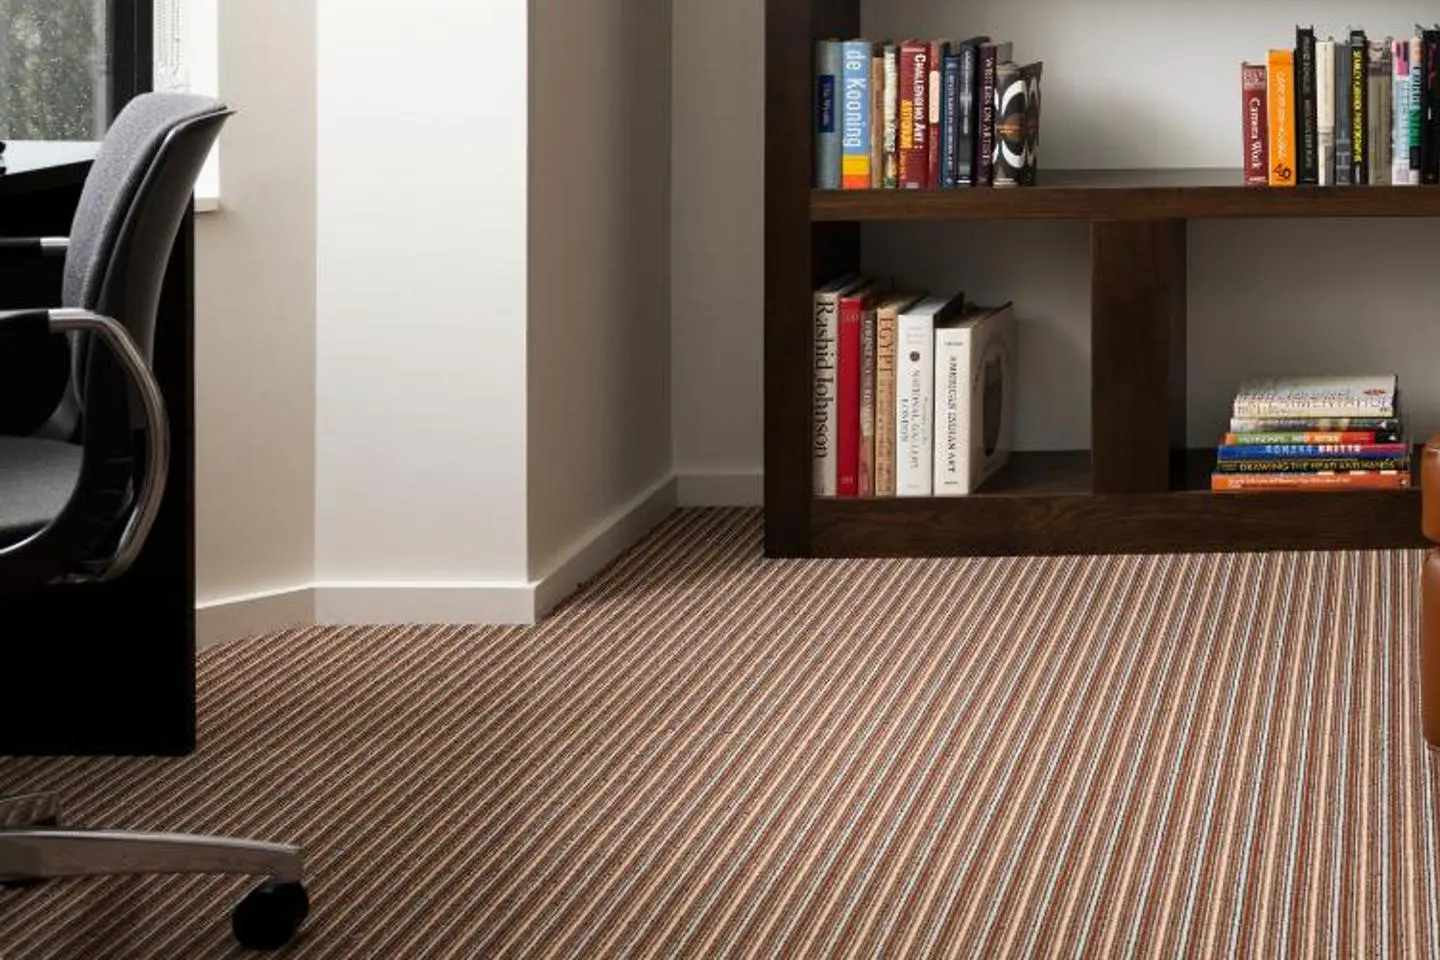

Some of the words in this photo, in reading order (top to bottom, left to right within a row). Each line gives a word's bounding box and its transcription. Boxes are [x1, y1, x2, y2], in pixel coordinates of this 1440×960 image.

[845, 49, 867, 70] de
[842, 77, 867, 148] Kooning
[1249, 97, 1262, 140] Camera
[1251, 141, 1263, 170] Work
[813, 299, 835, 370] Rashid
[878, 317, 894, 378] EGYPT
[813, 375, 835, 459] Johnson
